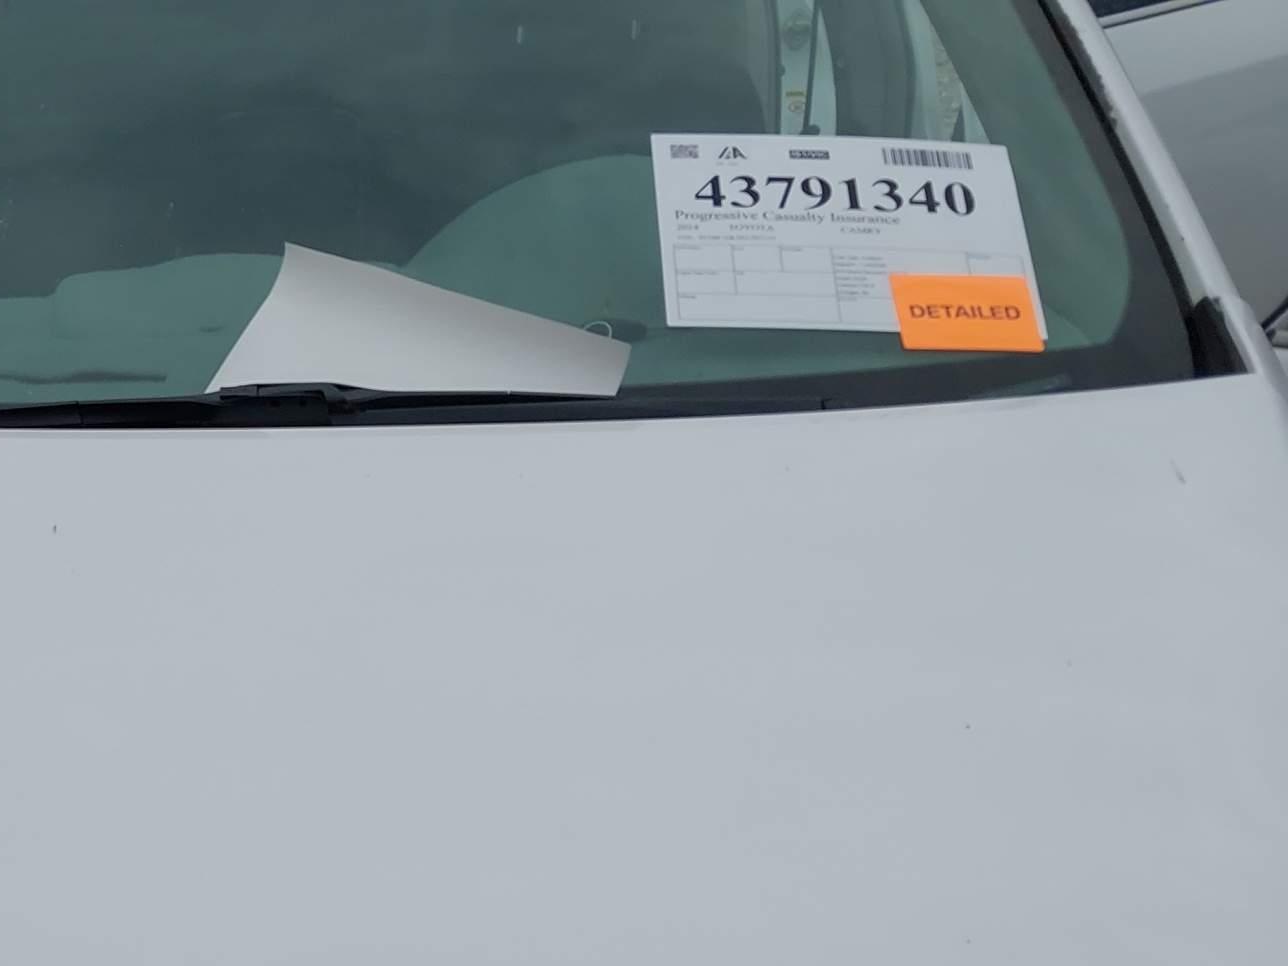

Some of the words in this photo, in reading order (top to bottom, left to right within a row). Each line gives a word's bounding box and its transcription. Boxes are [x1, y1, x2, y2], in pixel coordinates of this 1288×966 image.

[695, 175, 976, 217] 43791340
[675, 209, 758, 224] Progressive
[762, 211, 824, 225] Casualty
[830, 213, 901, 225] Insurance
[729, 224, 775, 232] TOYOTA
[909, 304, 1022, 321] DETAILED
